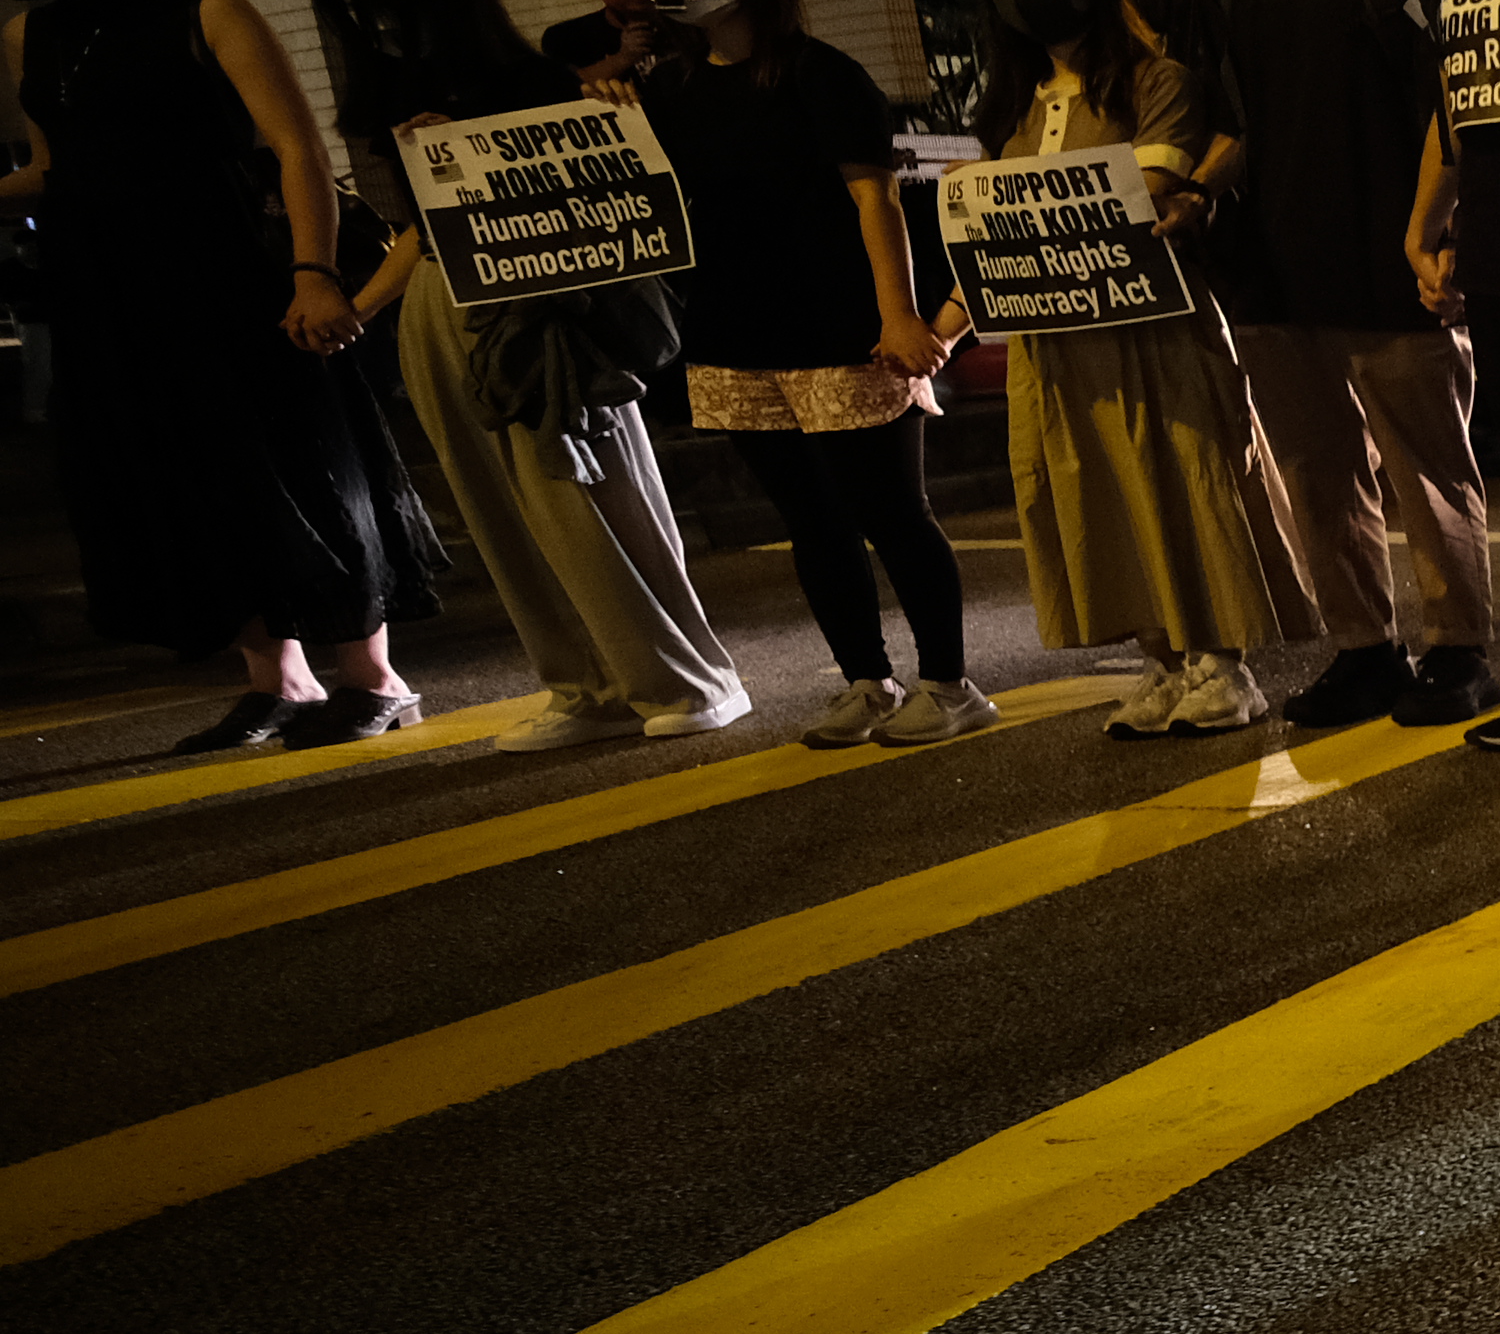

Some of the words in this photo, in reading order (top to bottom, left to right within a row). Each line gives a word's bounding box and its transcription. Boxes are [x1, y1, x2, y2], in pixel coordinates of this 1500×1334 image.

[424, 141, 456, 165] US
[465, 133, 491, 156] TO
[490, 111, 626, 163] SUPPORT
[456, 185, 486, 206] the
[485, 160, 568, 203] HONG
[562, 148, 647, 190] KONG
[947, 180, 964, 201] US
[974, 175, 990, 198] TO
[992, 161, 1113, 206] SUPPORT
[467, 205, 569, 246] Human
[566, 190, 653, 234] Rights
[964, 222, 985, 242] the
[981, 209, 1042, 242] HONG
[1039, 197, 1132, 236] KONG
[472, 238, 624, 286] Democracy
[631, 225, 671, 261] Act
[974, 248, 1042, 281] Human
[1039, 239, 1132, 282] Rights
[981, 285, 1101, 320] Democracy
[1106, 272, 1158, 309] Act
